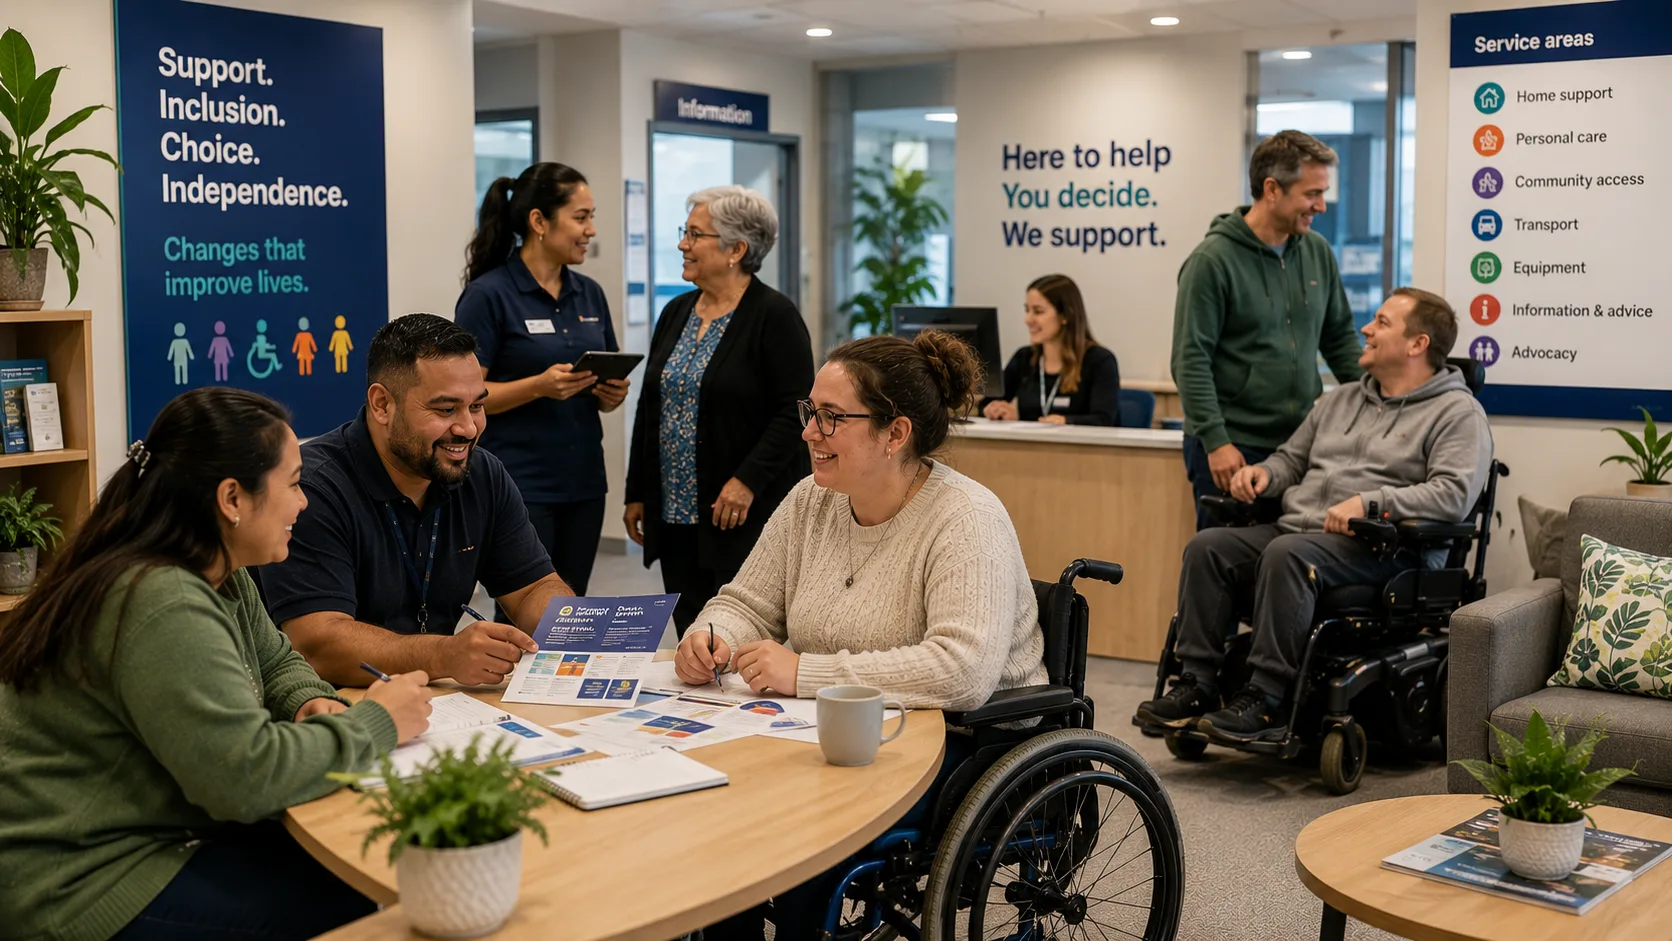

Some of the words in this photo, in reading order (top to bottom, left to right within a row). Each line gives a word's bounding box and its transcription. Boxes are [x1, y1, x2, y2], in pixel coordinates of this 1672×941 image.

[1474, 33, 1540, 53] Service
[1545, 32, 1595, 49] areas
[158, 46, 273, 88] Support.
[159, 89, 286, 127] Inclusion.
[1517, 90, 1556, 103] Home
[1559, 87, 1613, 104] support
[678, 97, 753, 126] Information
[160, 131, 260, 165] Choice.
[1516, 130, 1573, 145] Personal
[1577, 132, 1607, 143] care
[1002, 144, 1065, 171] Here
[1073, 144, 1100, 168] to
[1110, 139, 1171, 172] help
[162, 174, 348, 211] Independence.
[1002, 183, 1050, 209] You
[1058, 180, 1158, 208] decide.
[1515, 174, 1593, 190] Community
[1596, 175, 1645, 186] access
[1001, 221, 1043, 247] We
[1050, 222, 1166, 253] support.
[1514, 218, 1579, 234] Transport
[164, 236, 259, 266] Changes
[264, 237, 306, 261] that
[1513, 261, 1586, 277] Equipment
[165, 271, 253, 301] improve
[258, 269, 309, 294] lives.
[1512, 304, 1590, 317] Information
[1593, 304, 1604, 317] &
[1607, 304, 1653, 318] advice
[1512, 346, 1578, 363] Advocacy
